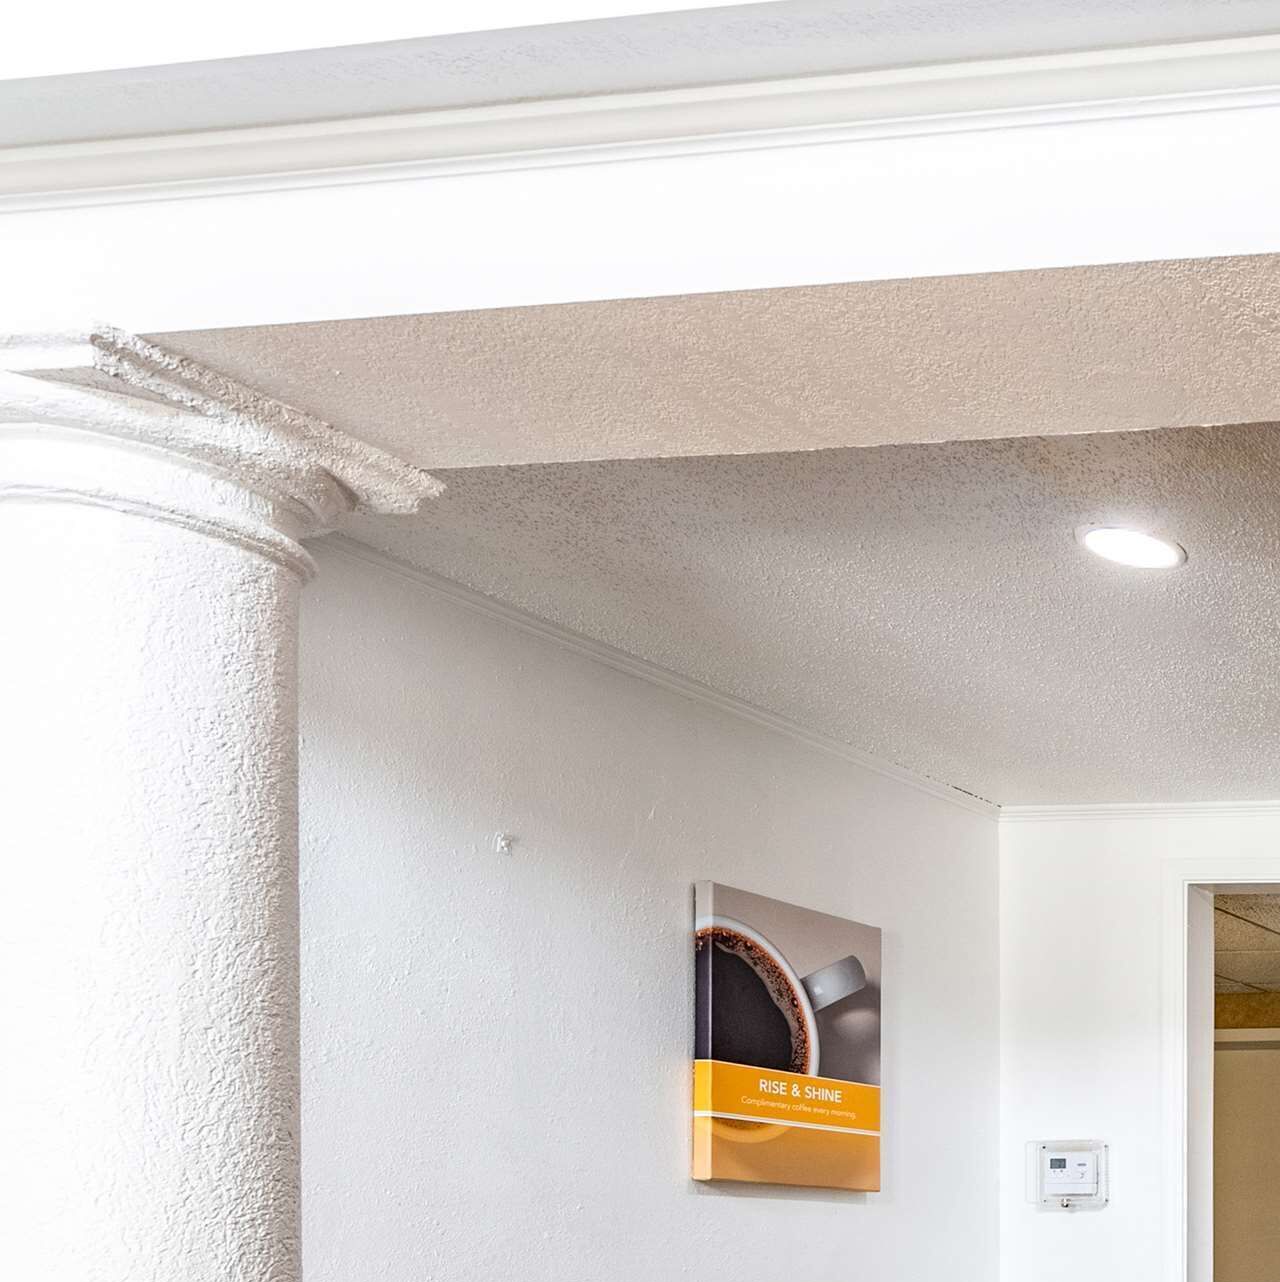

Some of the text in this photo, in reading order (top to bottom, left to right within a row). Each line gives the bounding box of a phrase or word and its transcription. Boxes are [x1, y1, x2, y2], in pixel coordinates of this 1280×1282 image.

[759, 1078, 843, 1104] RISE & SHINE
[740, 1095, 791, 1111] Complimentary
[791, 1103, 812, 1113] coffee
[813, 1107, 830, 1116] every
